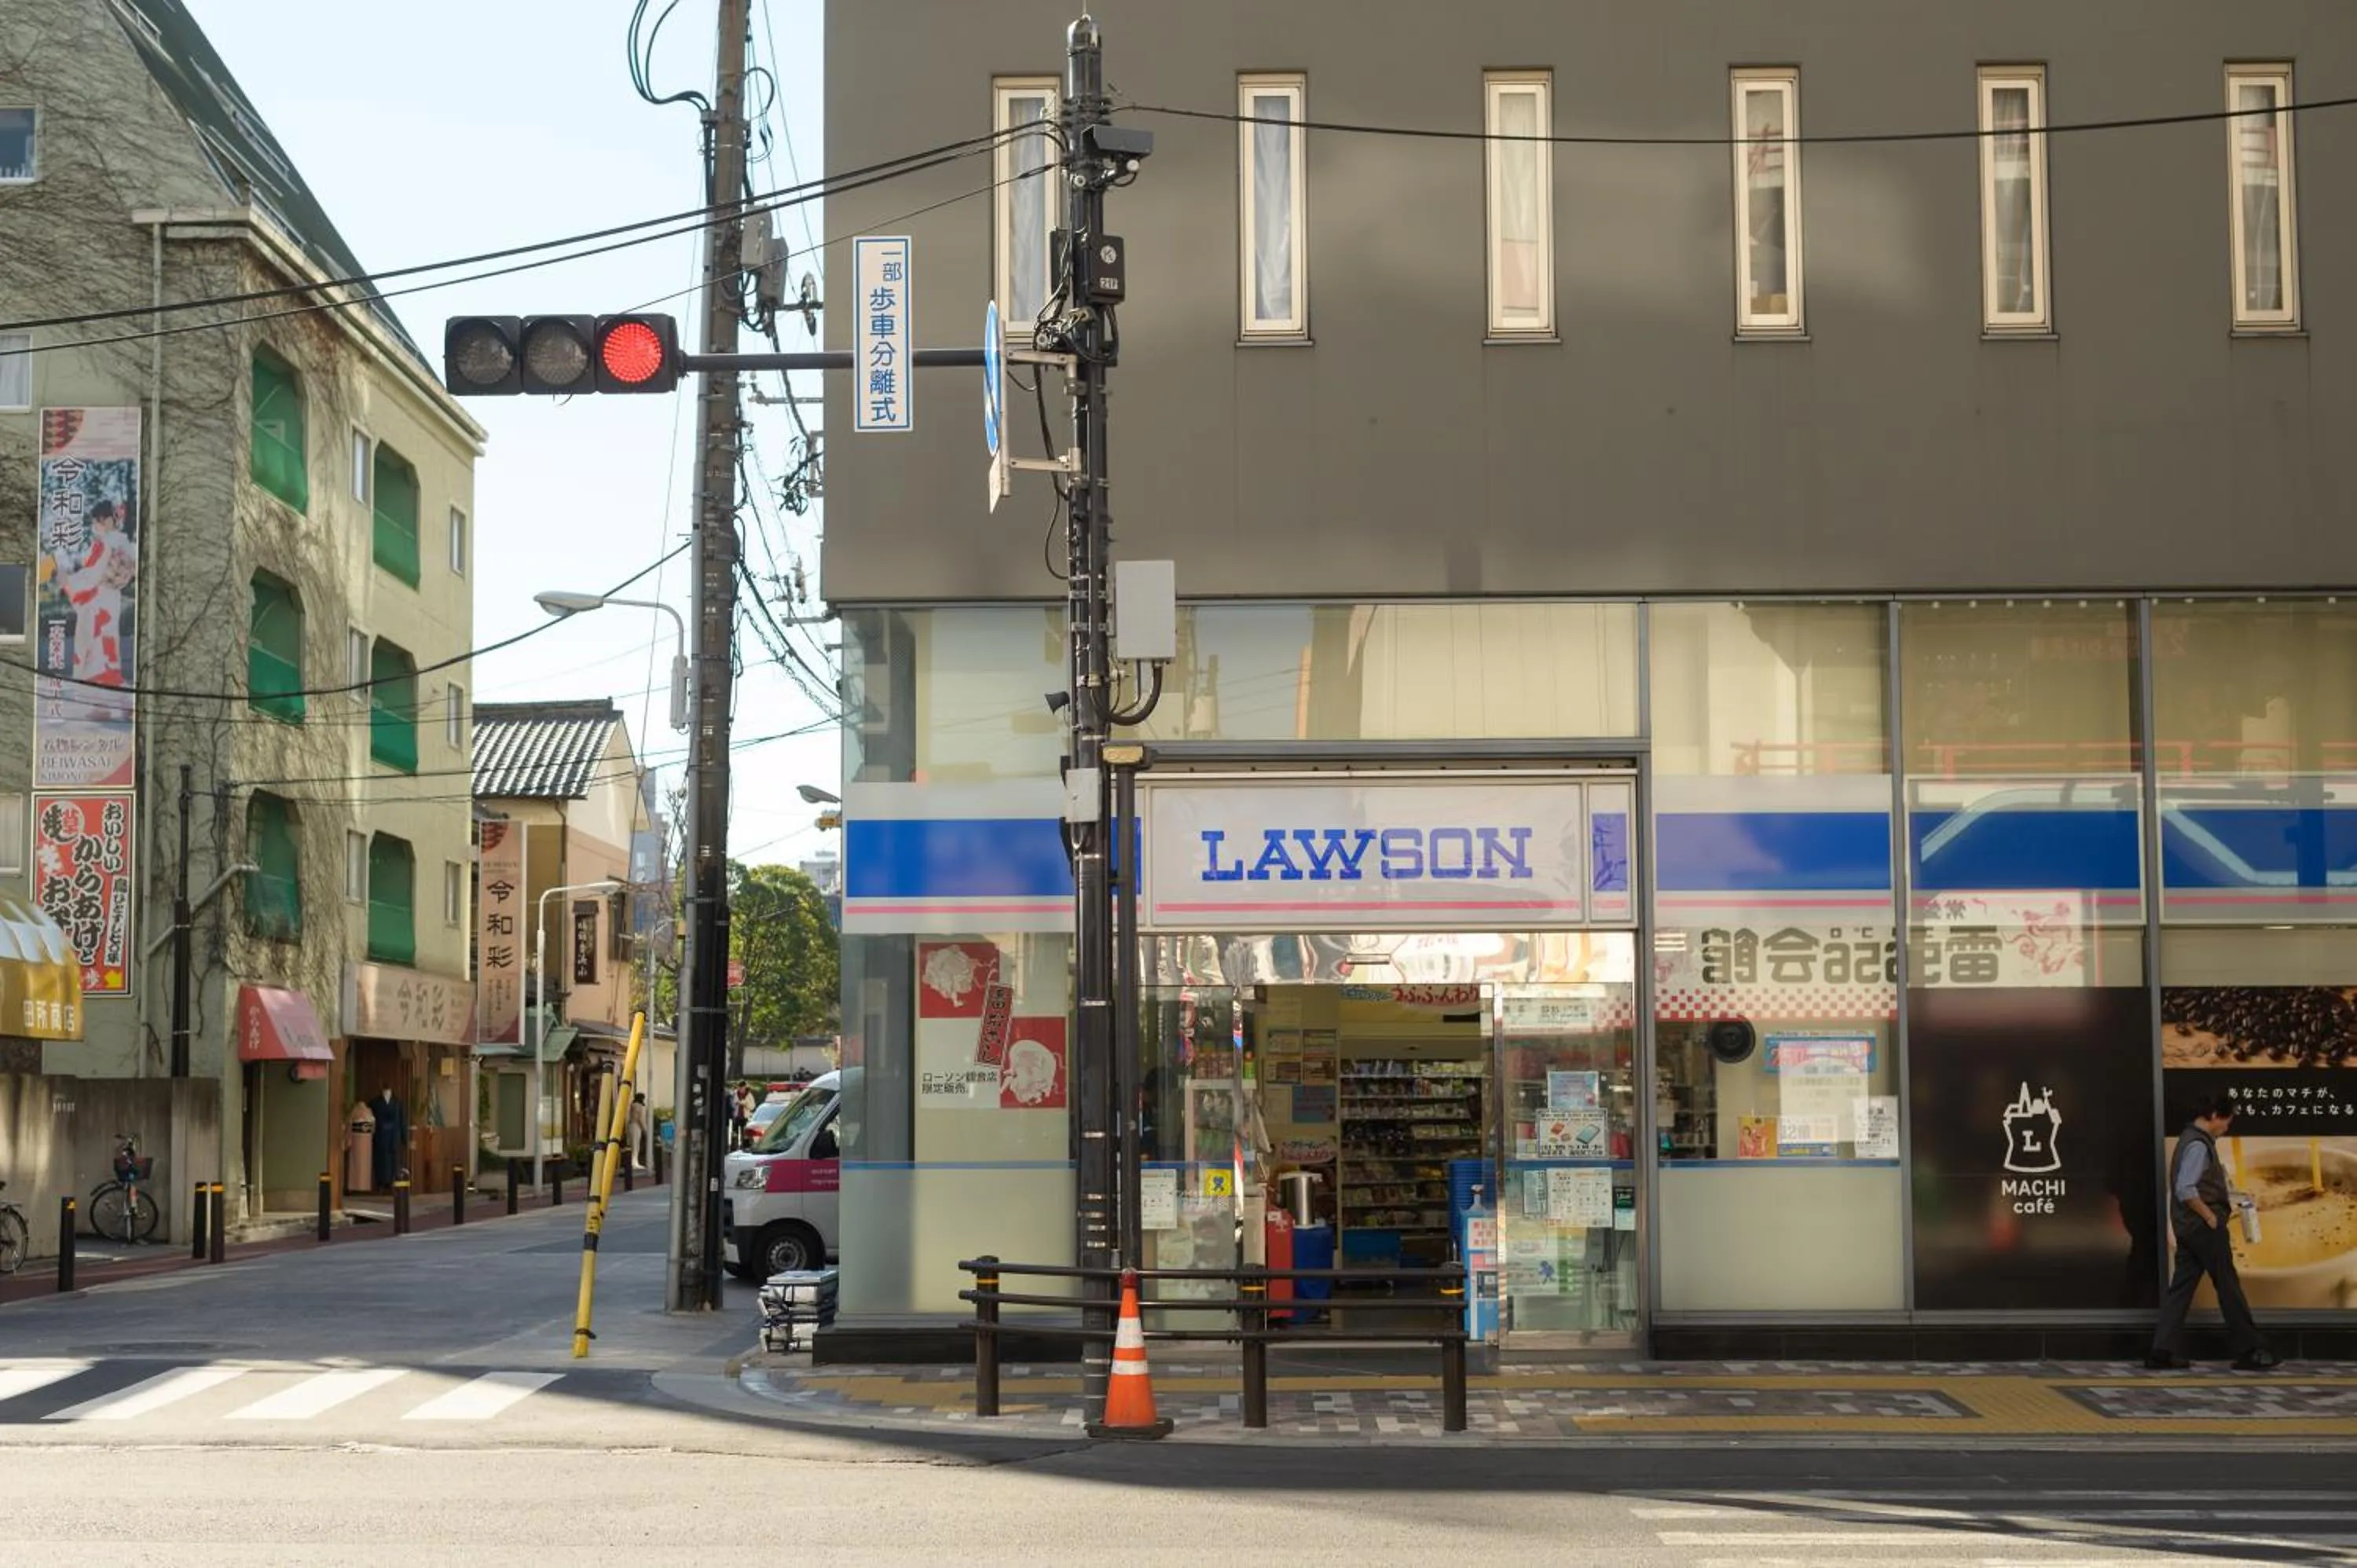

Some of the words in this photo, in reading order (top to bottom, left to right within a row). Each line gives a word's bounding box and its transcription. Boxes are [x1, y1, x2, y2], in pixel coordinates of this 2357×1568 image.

[881, 249, 903, 282] 一部
[869, 288, 896, 423] 歩車分離式
[51, 456, 86, 548] 令和彩
[103, 802, 124, 874] おいしい
[1202, 827, 1533, 881] LAWSON
[73, 834, 104, 965] からあげと
[486, 880, 515, 968] 令和彩
[2228, 1086, 2335, 1099] あなたのマチが、
[2001, 1180, 2066, 1196] MACHI
[2013, 1198, 2055, 1214] café
